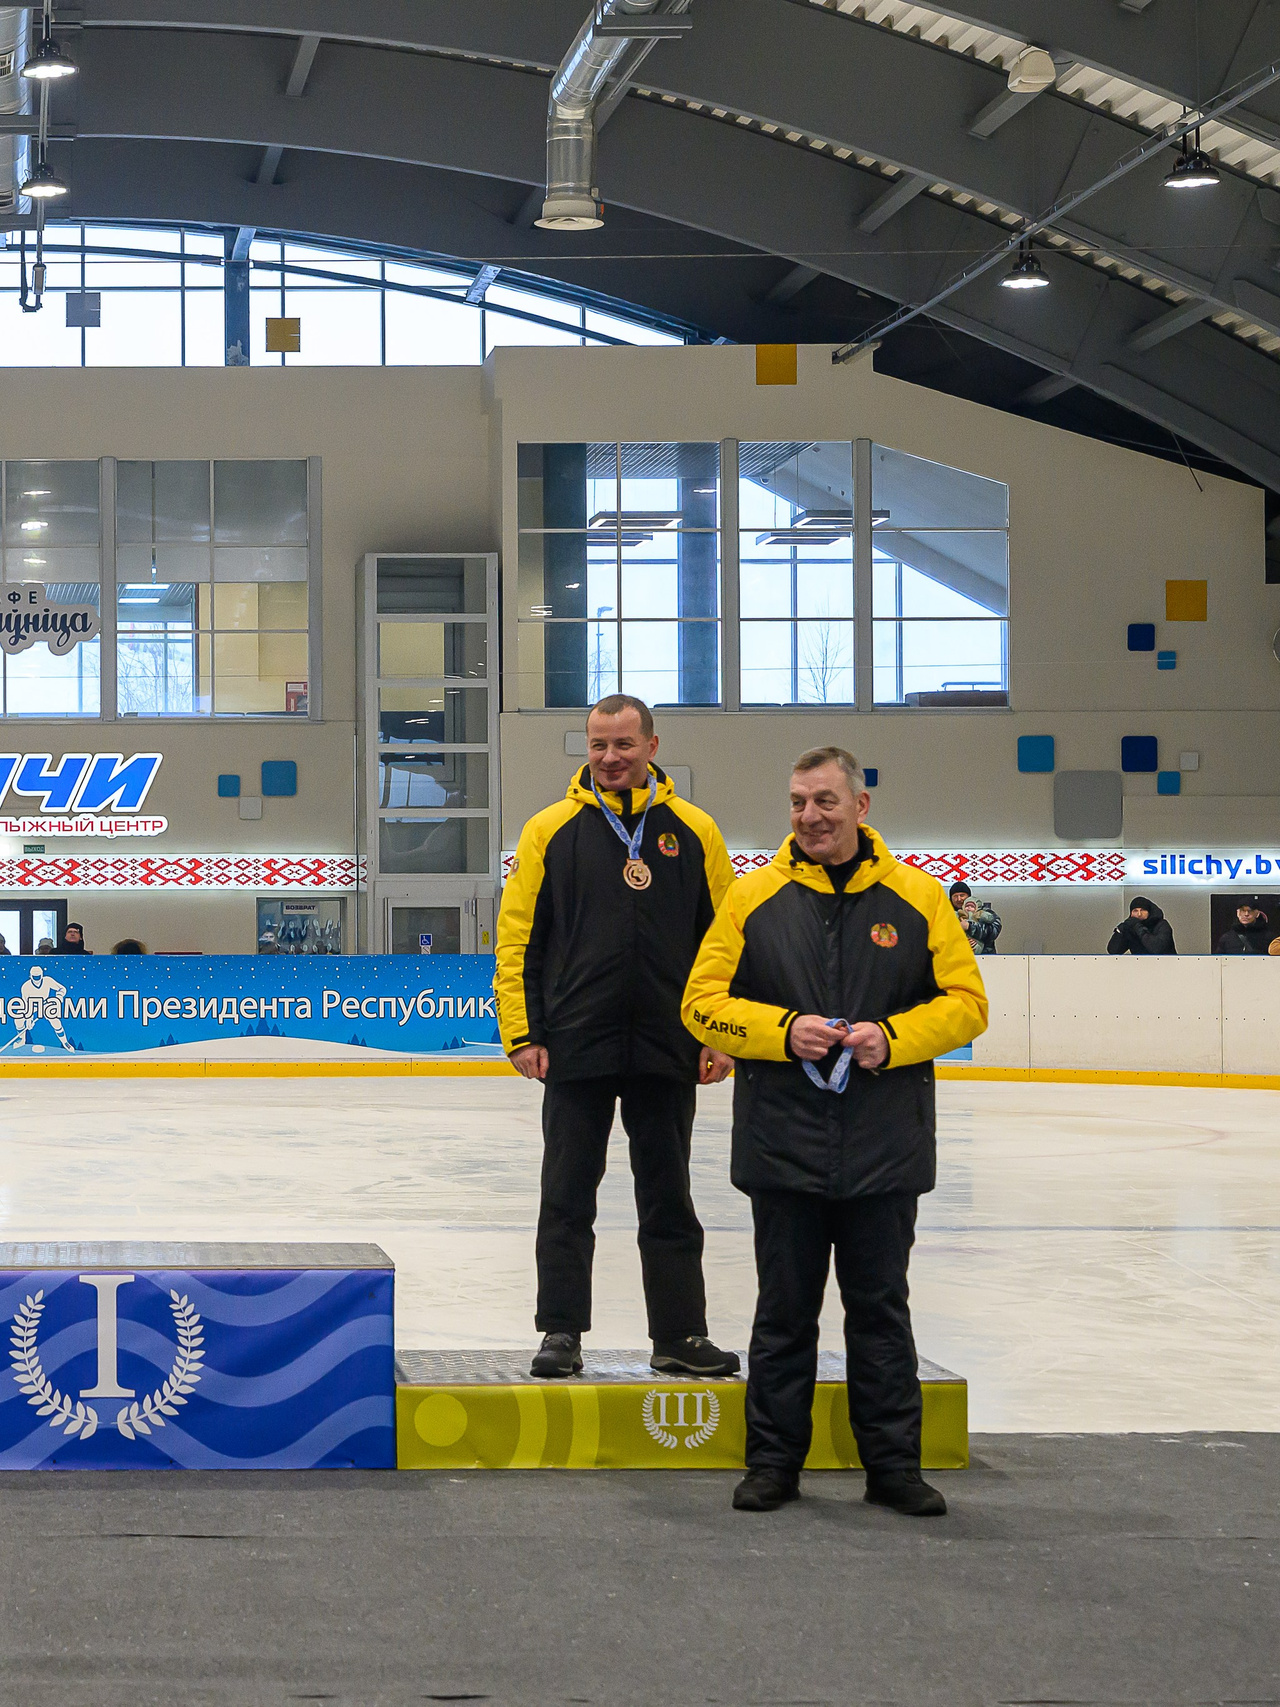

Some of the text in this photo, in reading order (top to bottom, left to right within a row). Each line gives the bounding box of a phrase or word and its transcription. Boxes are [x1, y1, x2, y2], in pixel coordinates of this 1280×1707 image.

[100, 820, 164, 835] ЦЕНТР
[118, 989, 312, 1026] Президента
[322, 988, 497, 1027] Республик
[693, 1009, 747, 1038] BEARUS
[658, 1392, 707, 1427] III
